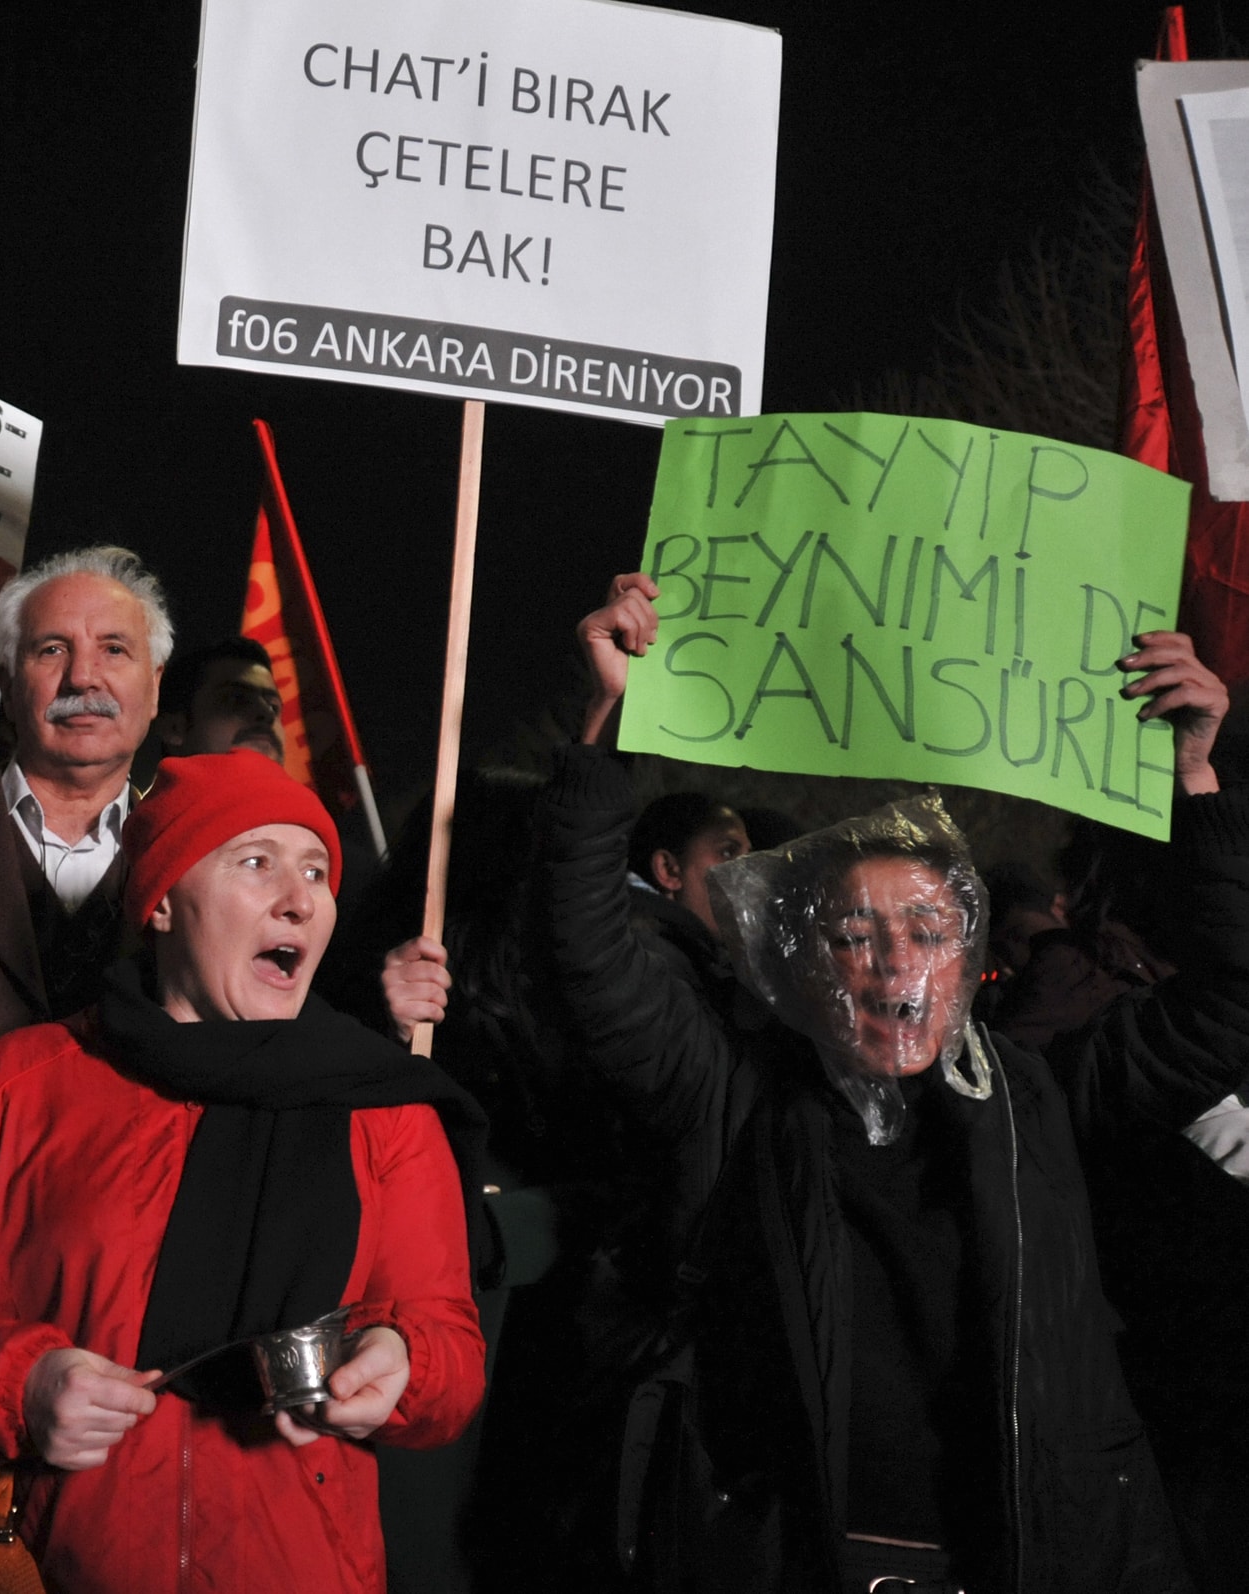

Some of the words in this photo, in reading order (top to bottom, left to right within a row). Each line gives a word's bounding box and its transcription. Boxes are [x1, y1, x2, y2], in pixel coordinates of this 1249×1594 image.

[511, 67, 672, 136] BIRAK
[355, 130, 628, 213] ÇETELERE
[421, 223, 553, 286] BAK!
[227, 308, 299, 354] f06
[310, 321, 495, 381] ANKARA
[509, 344, 734, 415] DİRENİYOR
[658, 632, 1175, 819] SANSÜRLE
